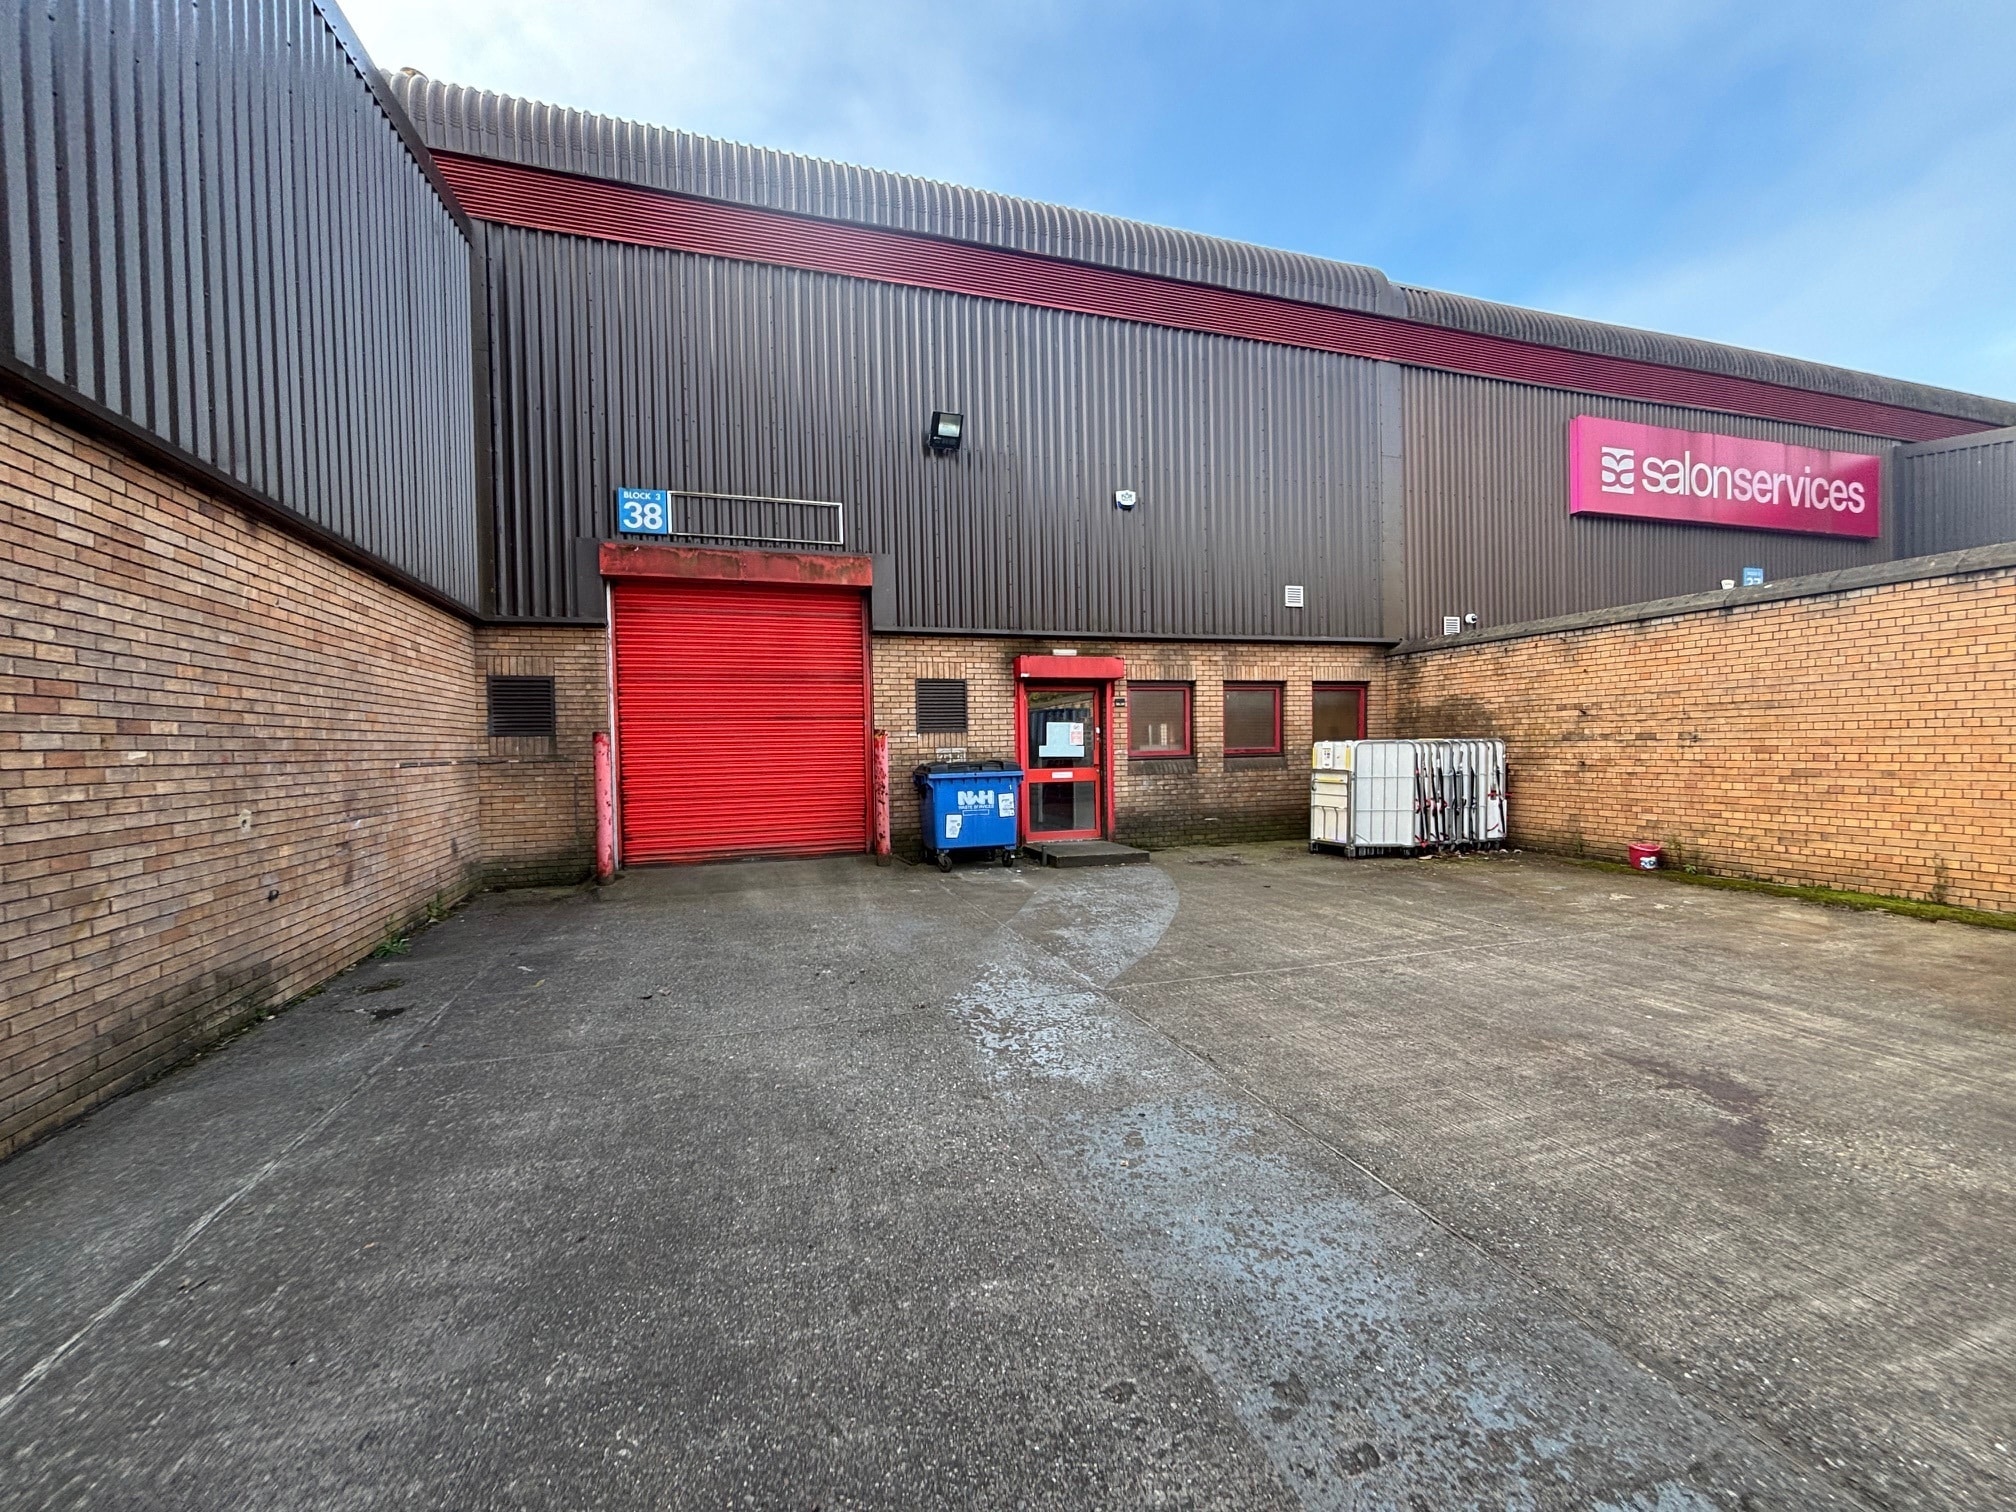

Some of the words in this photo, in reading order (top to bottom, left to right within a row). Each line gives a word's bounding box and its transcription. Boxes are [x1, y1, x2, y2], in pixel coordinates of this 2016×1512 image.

[623, 490, 651, 500] BLOCK
[655, 493, 661, 501] 3
[1641, 450, 1865, 513] salonservices
[623, 501, 663, 530] 38
